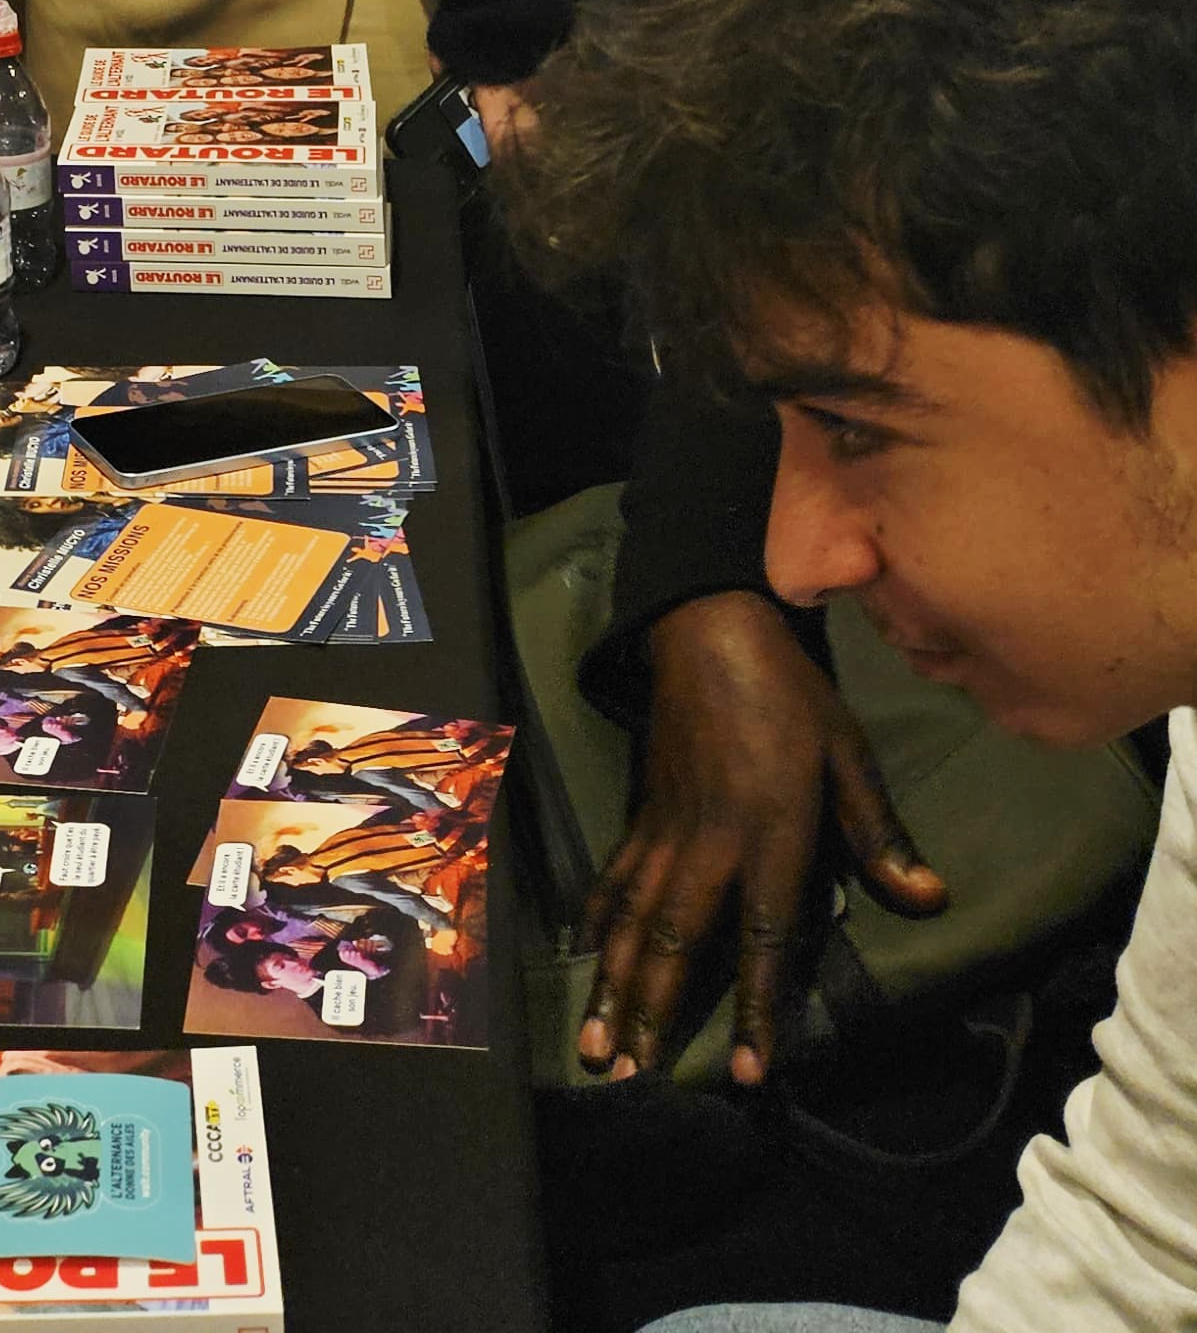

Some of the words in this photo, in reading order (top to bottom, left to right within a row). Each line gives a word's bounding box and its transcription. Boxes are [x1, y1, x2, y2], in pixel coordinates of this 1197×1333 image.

[90, 88, 294, 100] ROUTARD
[307, 88, 354, 99] LE
[76, 146, 294, 160] ROUTARD
[308, 148, 358, 161] LE
[120, 176, 187, 186] ROUTARD
[191, 176, 205, 186] LE
[216, 178, 269, 187] L'ALTERNANT
[269, 179, 281, 187] DE
[283, 179, 307, 188] GUIDE
[311, 180, 320, 188] LE
[129, 207, 195, 217] ROUTARD
[199, 208, 214, 218] LE
[223, 209, 277, 218] L'ALTERNANT
[279, 210, 289, 218] DE
[292, 210, 316, 218] GUIDE
[319, 211, 328, 219] LE
[128, 242, 194, 253] ROUTARD
[198, 243, 213, 253] LE
[223, 245, 276, 254] L'ALTERNANT
[278, 246, 288, 254] DE
[291, 246, 315, 255] GUIDE
[318, 247, 327, 255] LE
[135, 273, 202, 283] ROUTARD
[206, 274, 221, 283] LE
[231, 275, 285, 284] L'ALTERNANT
[286, 276, 297, 284] DE
[299, 276, 323, 285] GUIDE
[325, 277, 335, 285] LE
[25, 436, 40, 458] MUCYO
[18, 458, 36, 489] Christelle
[69, 469, 87, 490] NOS
[27, 554, 63, 589] Christelle
[56, 529, 86, 555] MUCYO
[78, 576, 108, 599] NOS
[99, 524, 150, 574] MISSIONS
[334, 974, 342, 990] bien
[333, 991, 342, 1014] cache
[348, 999, 356, 1012] son
[124, 1124, 135, 1149] AILES
[110, 1123, 123, 1198] L'ALTERNANCE
[125, 1149, 135, 1166] DES
[125, 1169, 135, 1200] DONNE
[242, 1167, 255, 1213] AFTRAL
[148, 1239, 249, 1288] LE
